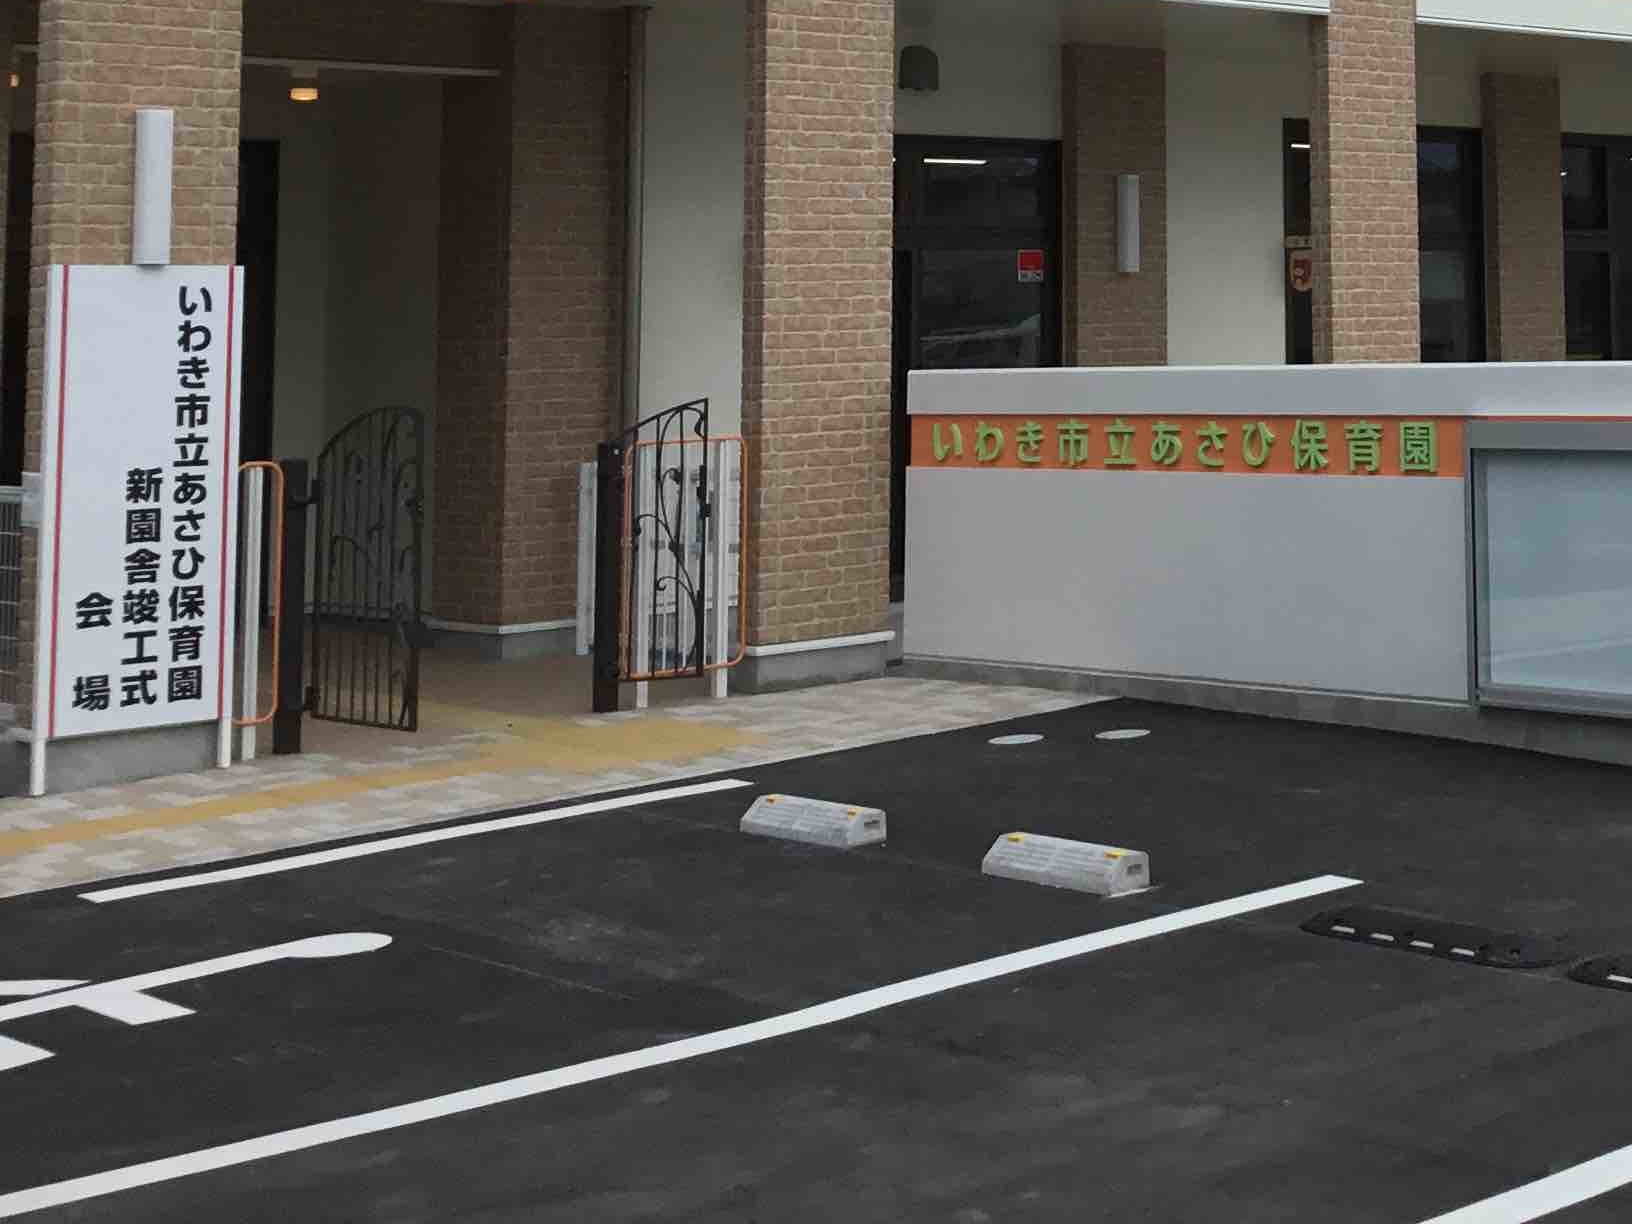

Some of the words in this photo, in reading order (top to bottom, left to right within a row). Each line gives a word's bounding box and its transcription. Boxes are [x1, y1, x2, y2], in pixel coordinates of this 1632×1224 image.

[167, 284, 212, 703] いわき市立あさひ保育園
[931, 417, 1439, 474] いわき市立あさひ保育園
[119, 466, 163, 708] 新園舎竣工式
